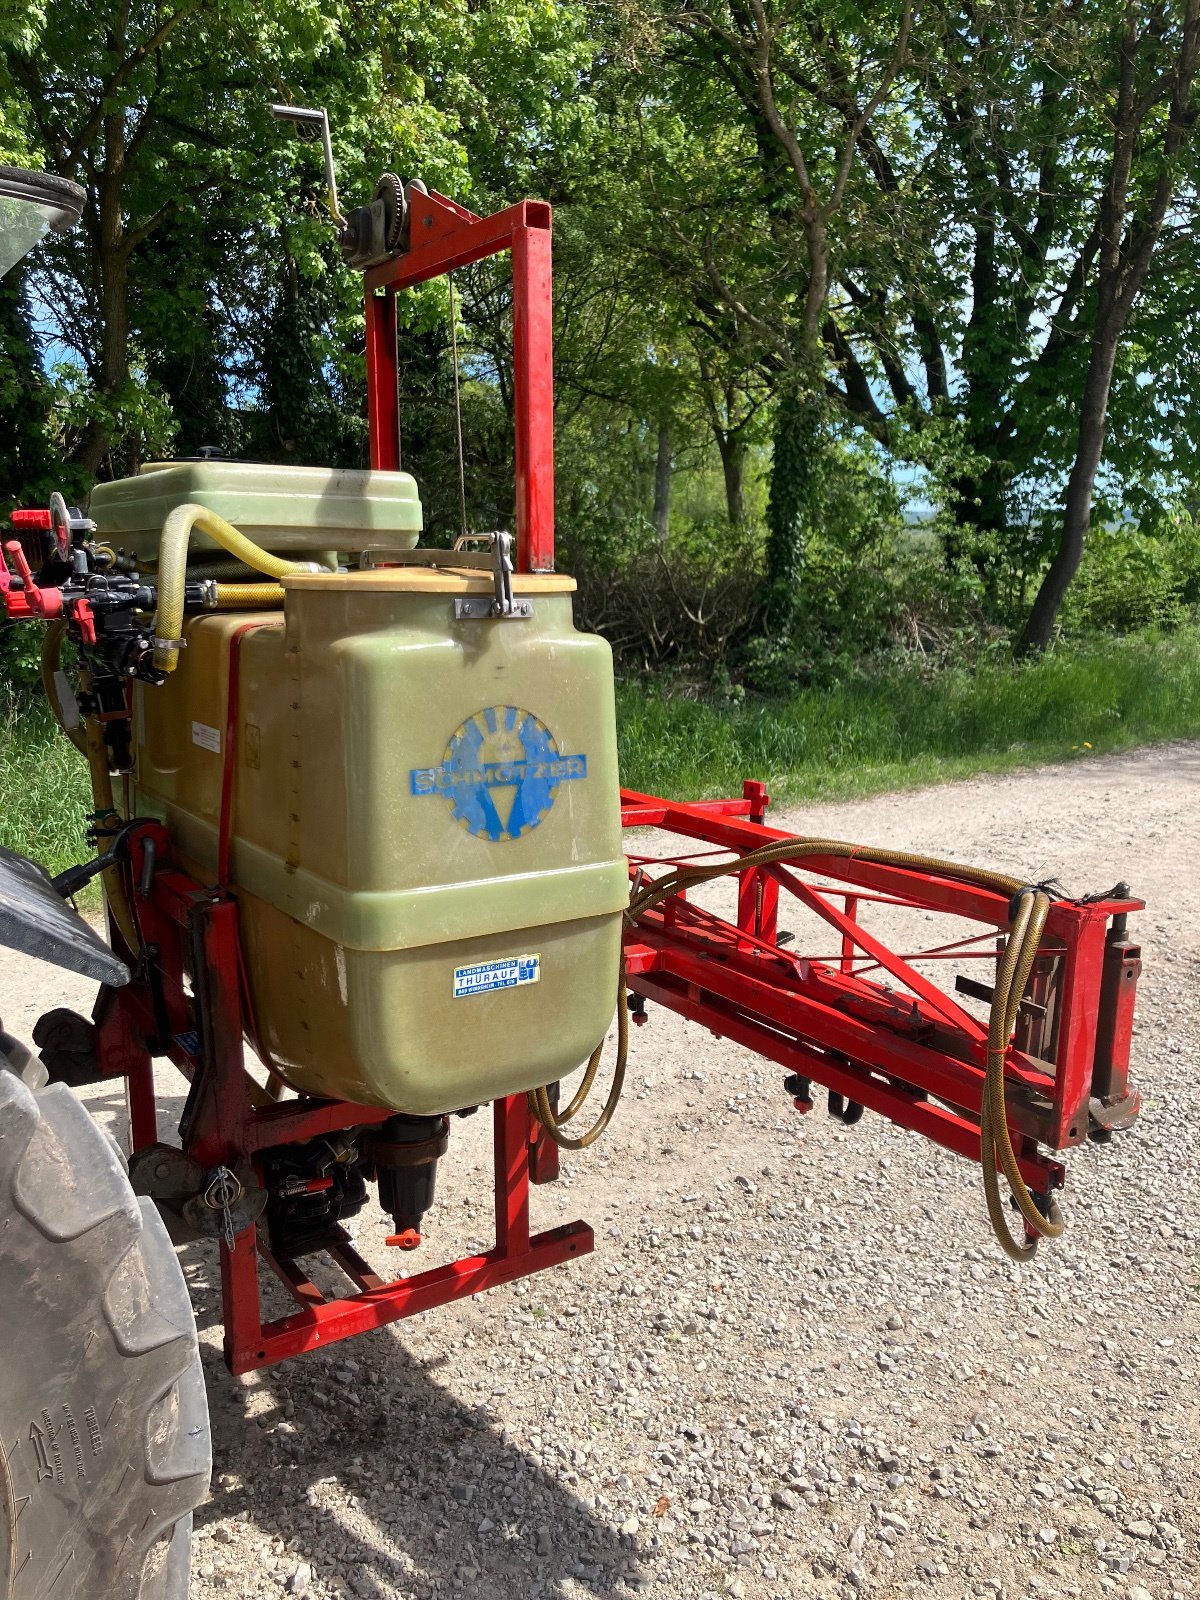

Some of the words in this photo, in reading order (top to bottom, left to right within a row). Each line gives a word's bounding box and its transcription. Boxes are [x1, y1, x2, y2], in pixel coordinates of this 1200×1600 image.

[415, 759, 584, 791] SCHMOTZER
[458, 961, 516, 976] LANDMASCHINEN
[458, 969, 516, 987] THÜRAUF
[41, 1408, 56, 1441] DIRECTION
[62, 1403, 72, 1418] MAY
[70, 1428, 80, 1446] USED
[84, 1406, 103, 1456] TUBELESS
[51, 1443, 60, 1452] OF
[54, 1453, 64, 1486] ROTATION
